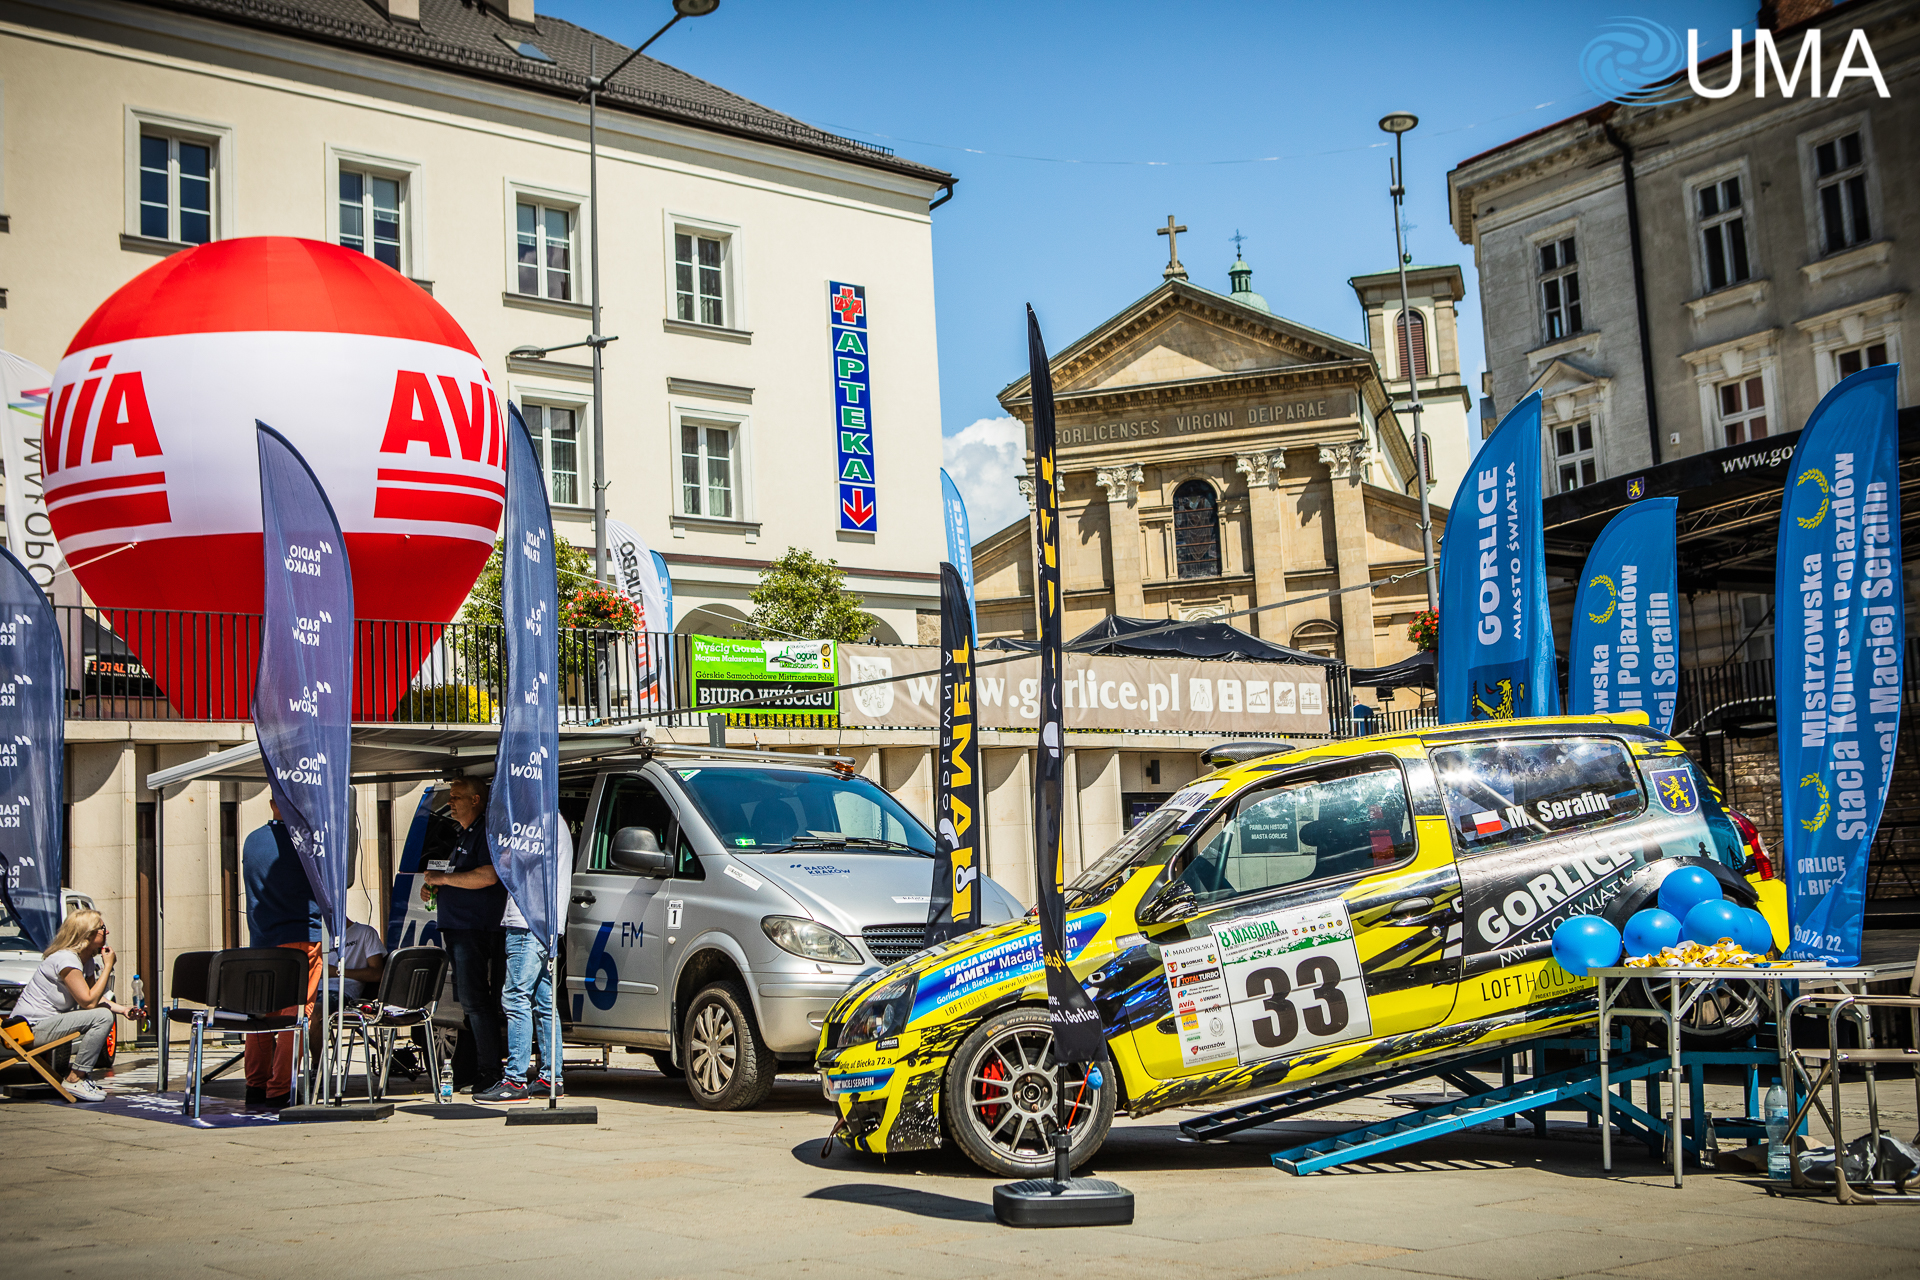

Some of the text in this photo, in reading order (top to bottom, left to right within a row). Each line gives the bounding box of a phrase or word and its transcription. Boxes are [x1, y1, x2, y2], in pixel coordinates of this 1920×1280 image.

[41, 354, 163, 480] VIA
[379, 368, 507, 472] AVI
[835, 331, 872, 482] APTEKA
[1176, 411, 1234, 432] VIRGINI
[1248, 400, 1327, 424] DEIPARAE
[1721, 444, 1797, 474] www.go
[1831, 452, 1857, 602] Pojazdów
[1861, 481, 1893, 600] Serafin
[1478, 467, 1502, 645] GORLICE
[1505, 461, 1522, 640] MIASTO ŚWIATŁA
[695, 641, 730, 654] Wyścig
[1617, 564, 1640, 685] Pojazdów
[1646, 592, 1677, 686] Serafin
[1800, 552, 1827, 748] Mistrzowska
[1863, 604, 1900, 714] Maciej
[695, 671, 725, 679] Górskie
[727, 672, 777, 681] Samochodowe
[778, 673, 817, 682] Mistrzostwa
[699, 685, 833, 706] BIURO WYŚCIGU
[1505, 805, 1535, 829] M.
[1537, 791, 1610, 823] Serafin
[1829, 741, 1868, 841] Stacja
[1269, 832, 1288, 840] GORLICE
[1797, 856, 1846, 875] ORLICE
[1477, 836, 1633, 944] GORLICE
[621, 921, 644, 948] FM
[999, 945, 1038, 970] Maciej
[1172, 942, 1215, 957] MAŁOPOLSKA
[1499, 915, 1566, 969] MIASTO
[944, 956, 980, 978] STACJA
[980, 938, 1028, 962] KONTROLI
[936, 991, 962, 1005] Gorlice,
[962, 984, 972, 994] ul.
[994, 971, 1005, 981] 72
[1021, 959, 1045, 972] czynn
[944, 990, 990, 1017] LOFTHOUSE
[1244, 955, 1349, 1049] 33
[852, 1076, 875, 1088] SERAFIN
[876, 1056, 886, 1066] 72
